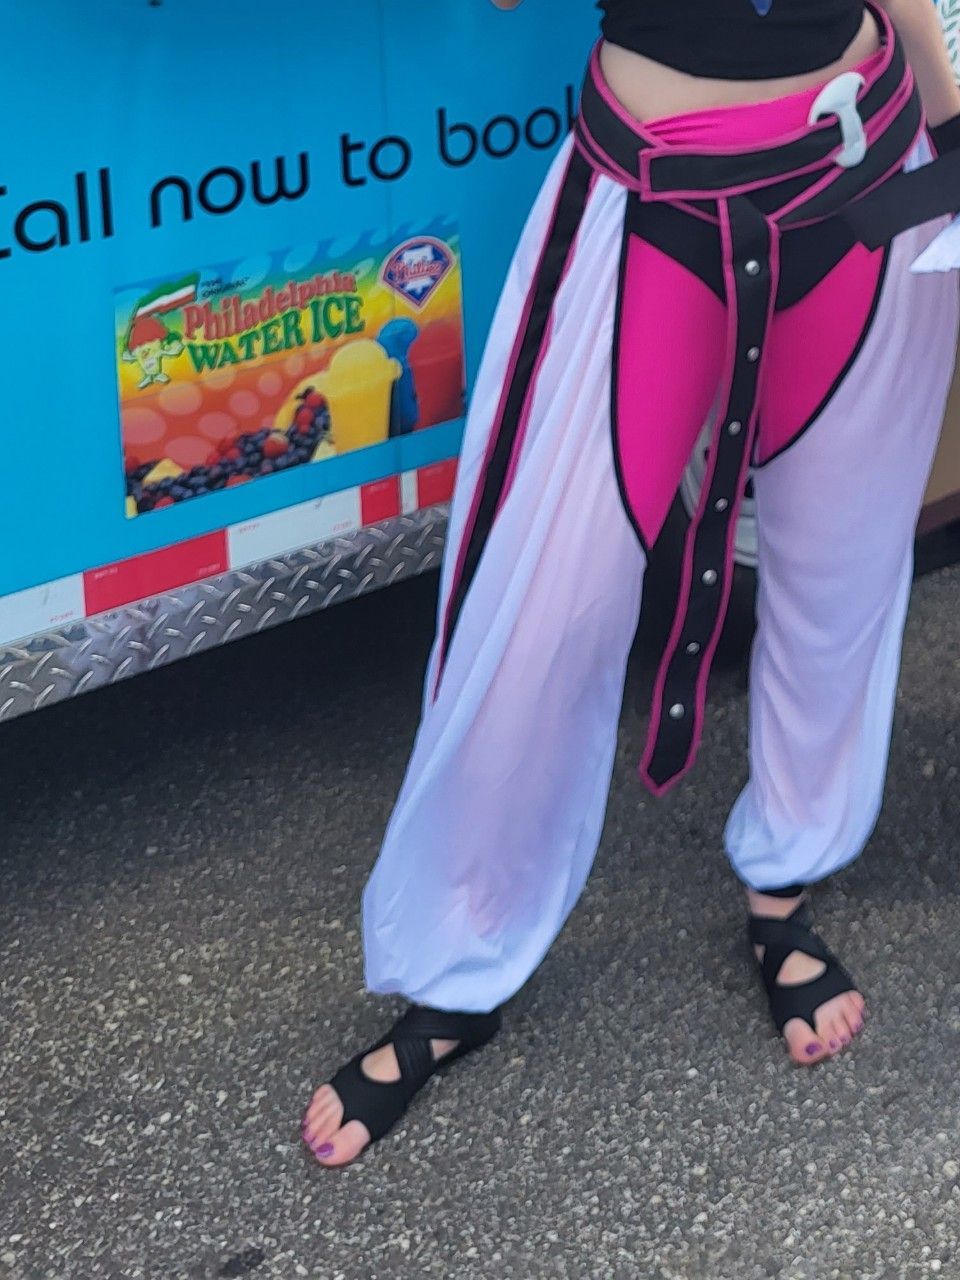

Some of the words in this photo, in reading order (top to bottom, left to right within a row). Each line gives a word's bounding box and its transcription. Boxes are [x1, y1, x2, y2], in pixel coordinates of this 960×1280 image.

[148, 151, 310, 229] now
[339, 131, 413, 189] to
[182, 270, 357, 342] Philadelphia
[186, 310, 306, 374] WATER
[310, 294, 366, 345] ICE
